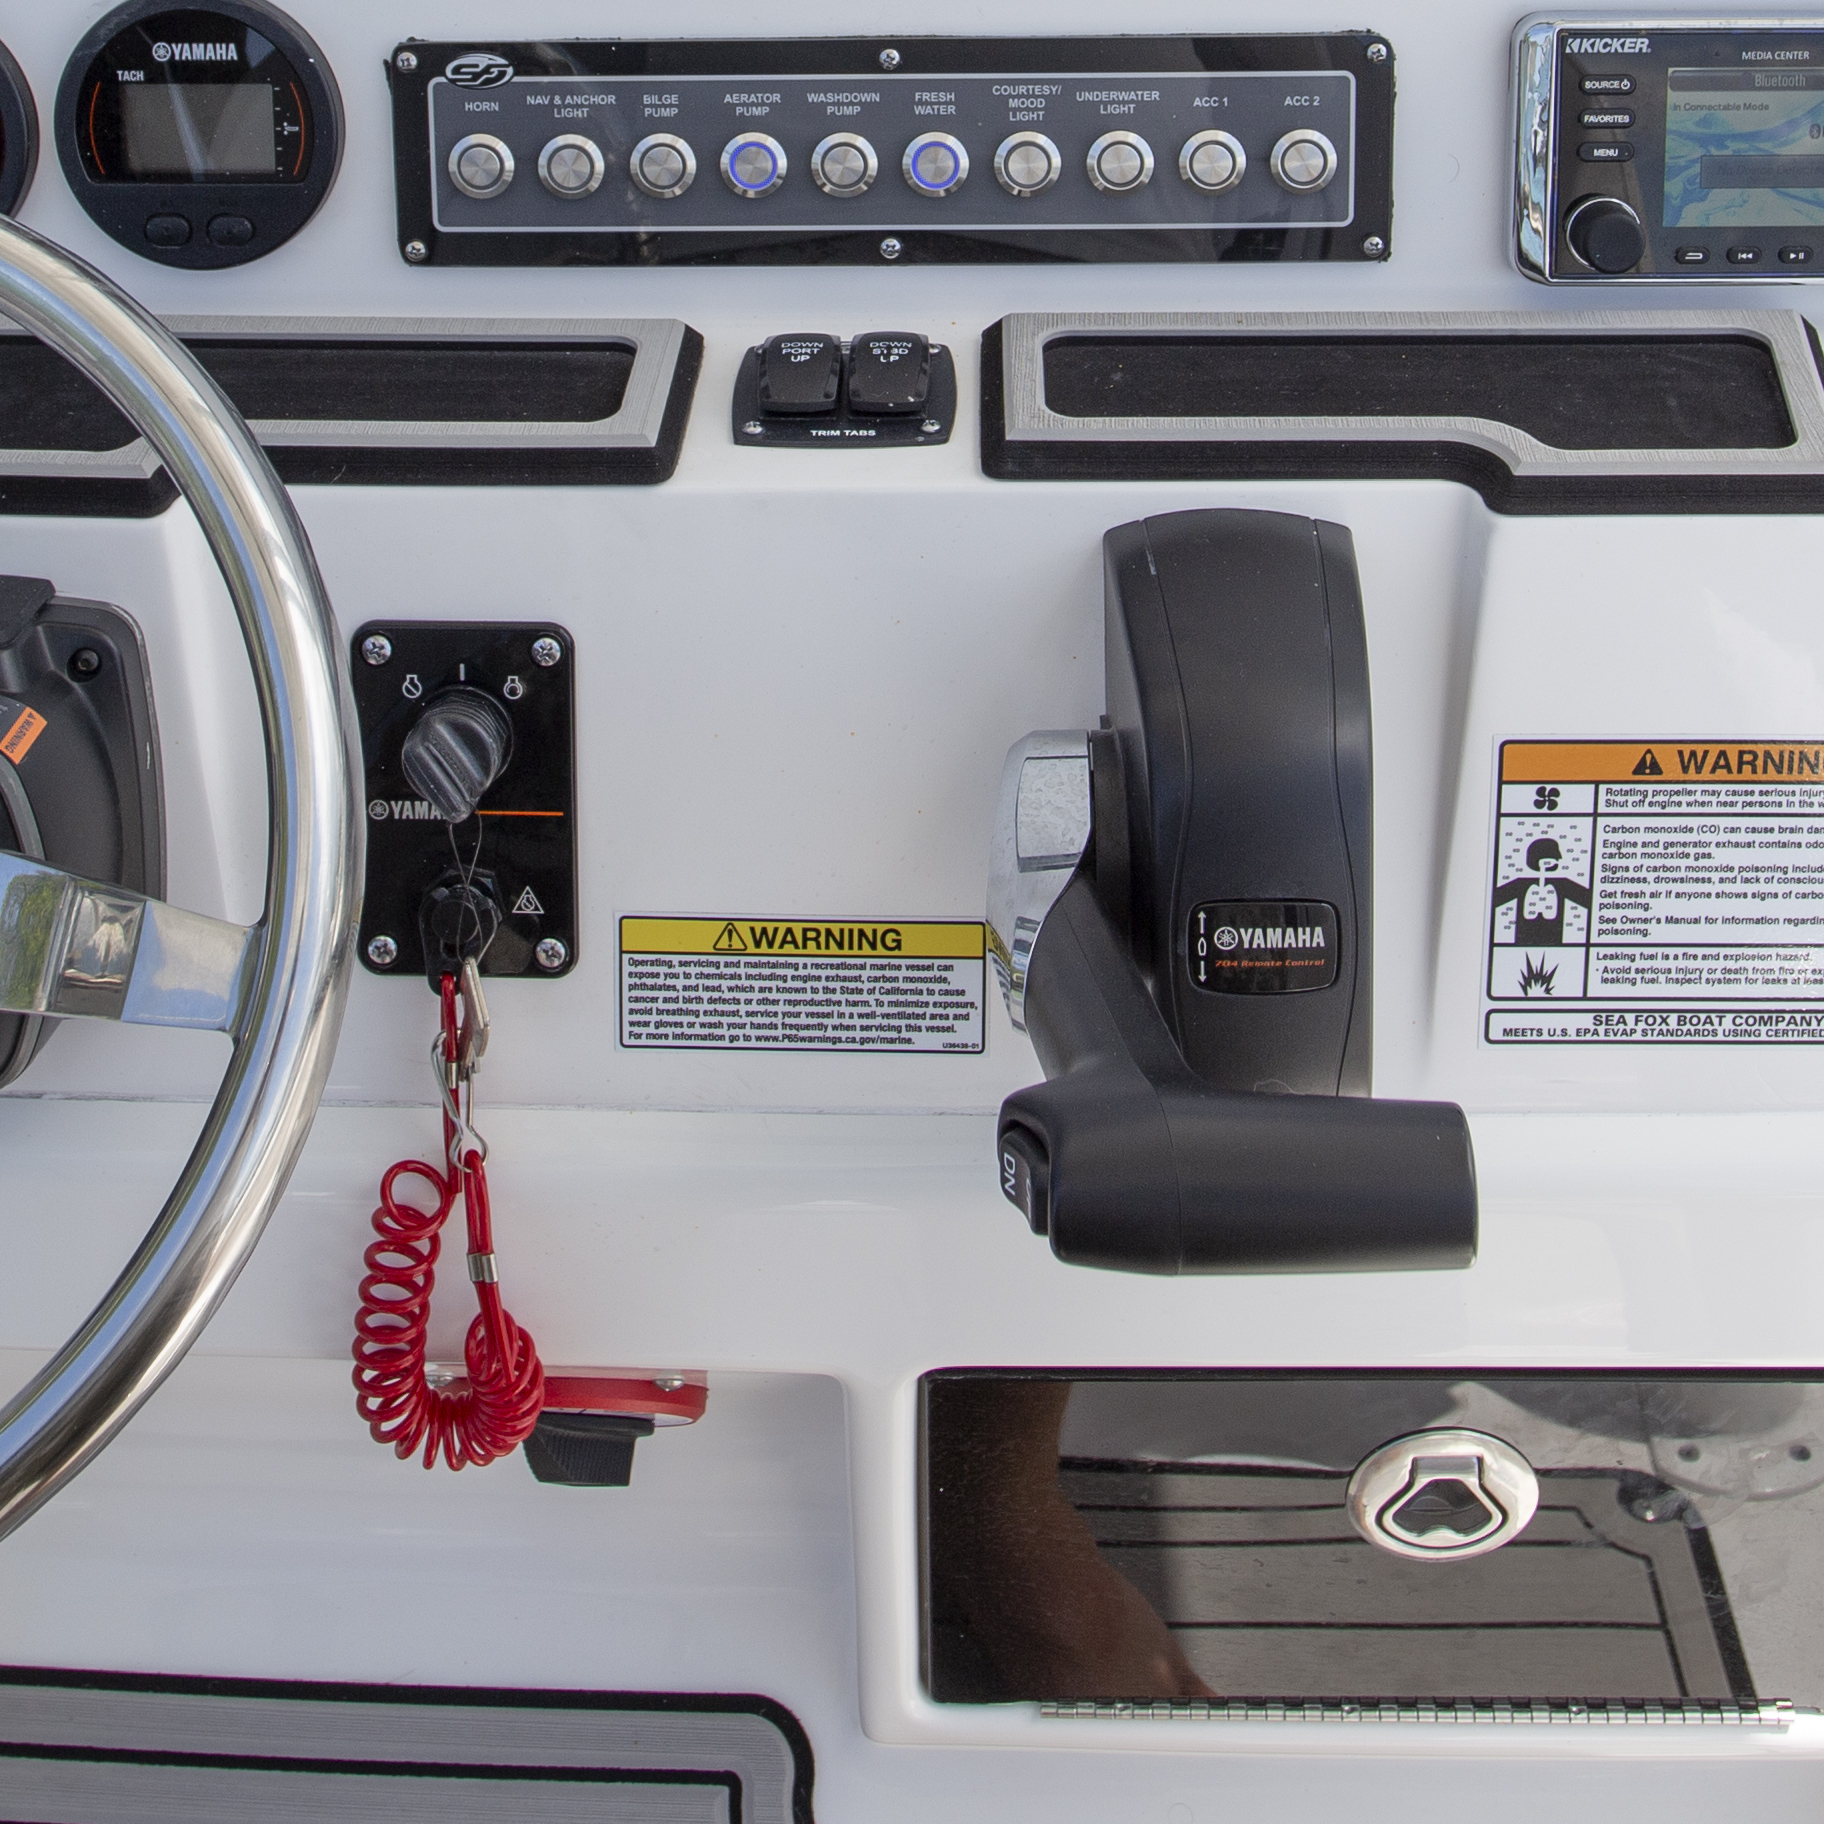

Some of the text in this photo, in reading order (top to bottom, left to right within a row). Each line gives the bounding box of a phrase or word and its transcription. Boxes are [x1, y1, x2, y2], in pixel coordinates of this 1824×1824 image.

[169, 42, 238, 60] YAMAHA
[1741, 50, 1810, 60] MEDIA CENTER
[115, 69, 144, 81] TACH
[1584, 80, 1620, 89] SOURCE
[1754, 74, 1806, 88] Bluetooth
[991, 84, 1062, 95] COURTESY/
[525, 93, 616, 105] NAV & ANCHOR
[642, 93, 679, 104] BILGE
[722, 92, 782, 103] AERATOR
[806, 92, 880, 102] WASHDOWN
[914, 91, 955, 102] FRESH
[1075, 90, 1160, 101] UNDERWATER
[1283, 94, 1320, 106] ACC 2
[464, 100, 499, 112] HORN
[1008, 97, 1046, 108] MOOD
[1192, 96, 1228, 107] ACC 1
[1672, 101, 1770, 112] In Connectable Mode
[553, 107, 590, 118] LIGHT
[643, 106, 679, 117] PUMP
[735, 105, 770, 116] PUMP
[826, 104, 861, 116] PUMP
[913, 104, 956, 115] WATER
[1099, 103, 1136, 114] LIGHT
[1008, 110, 1045, 121] LIGHT
[1583, 114, 1630, 123] FAVORITES
[1593, 148, 1619, 157] MENU
[4, 718, 34, 754] WARNING
[1604, 786, 1649, 800] Rotating
[1650, 787, 1698, 800] propeller
[1700, 788, 1722, 799] may
[1724, 788, 1756, 797] cause
[1757, 787, 1796, 800] serious
[390, 800, 448, 820] YAMA
[749, 924, 903, 953] WARNING
[1240, 926, 1326, 948] YAMAHA
[1215, 958, 1325, 968] 704 Remote Control
[1592, 1013, 1824, 1027] SEA FOX BOAT COMPANY
[627, 1030, 915, 1045] For more information go to www.P65warnings.ca.gov/marine.
[1502, 1027, 1544, 1037] MEETS
[1546, 1027, 1572, 1037] U.S.
[1574, 1027, 1600, 1037] EPA
[1603, 1027, 1637, 1037] EVAP
[1640, 1027, 1718, 1037] STANDARDS
[1722, 1027, 1762, 1038] USING
[1003, 1152, 1016, 1196] DN
